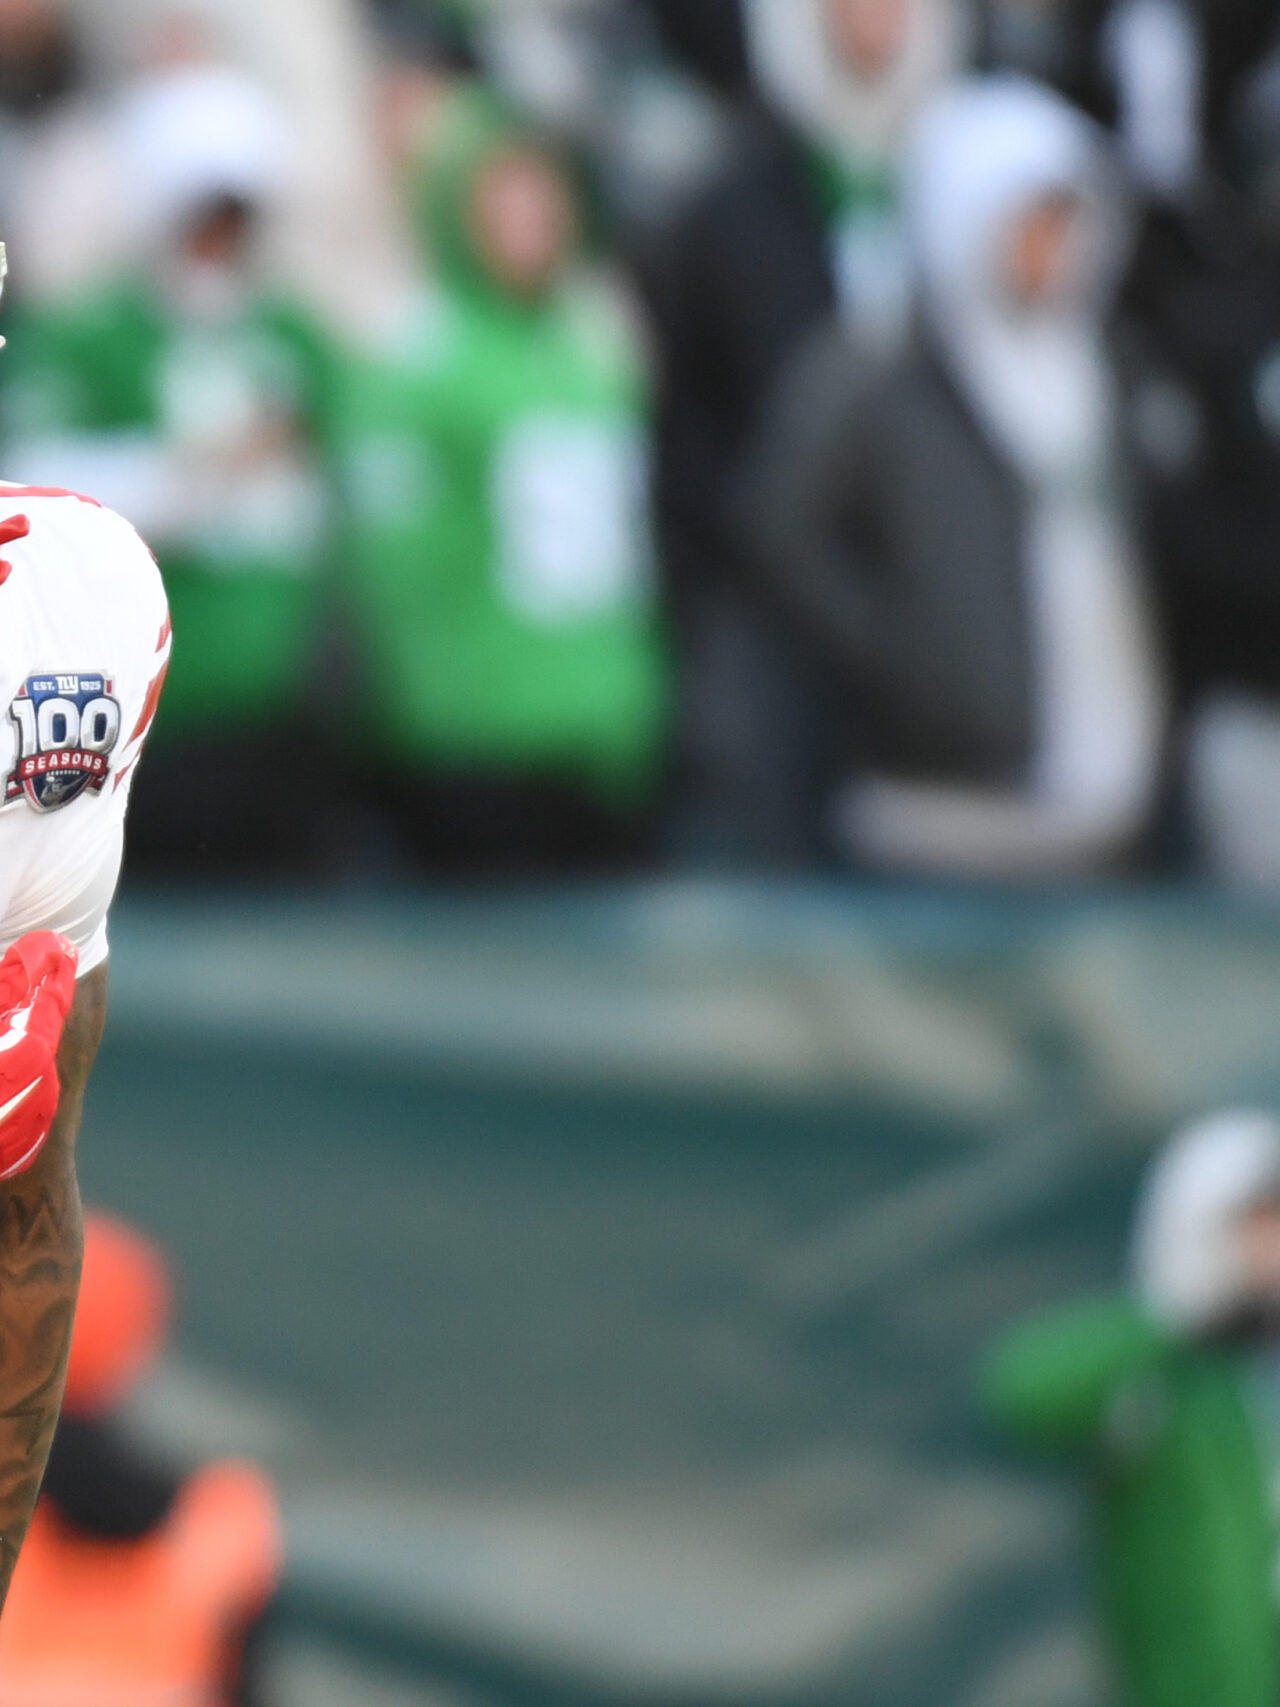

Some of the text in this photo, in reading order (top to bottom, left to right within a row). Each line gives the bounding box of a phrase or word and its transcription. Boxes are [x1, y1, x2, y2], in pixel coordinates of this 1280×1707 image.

[33, 681, 56, 692] EST.
[80, 680, 102, 691] 1925
[11, 697, 121, 754] 100
[24, 753, 103, 773] SEASONS
